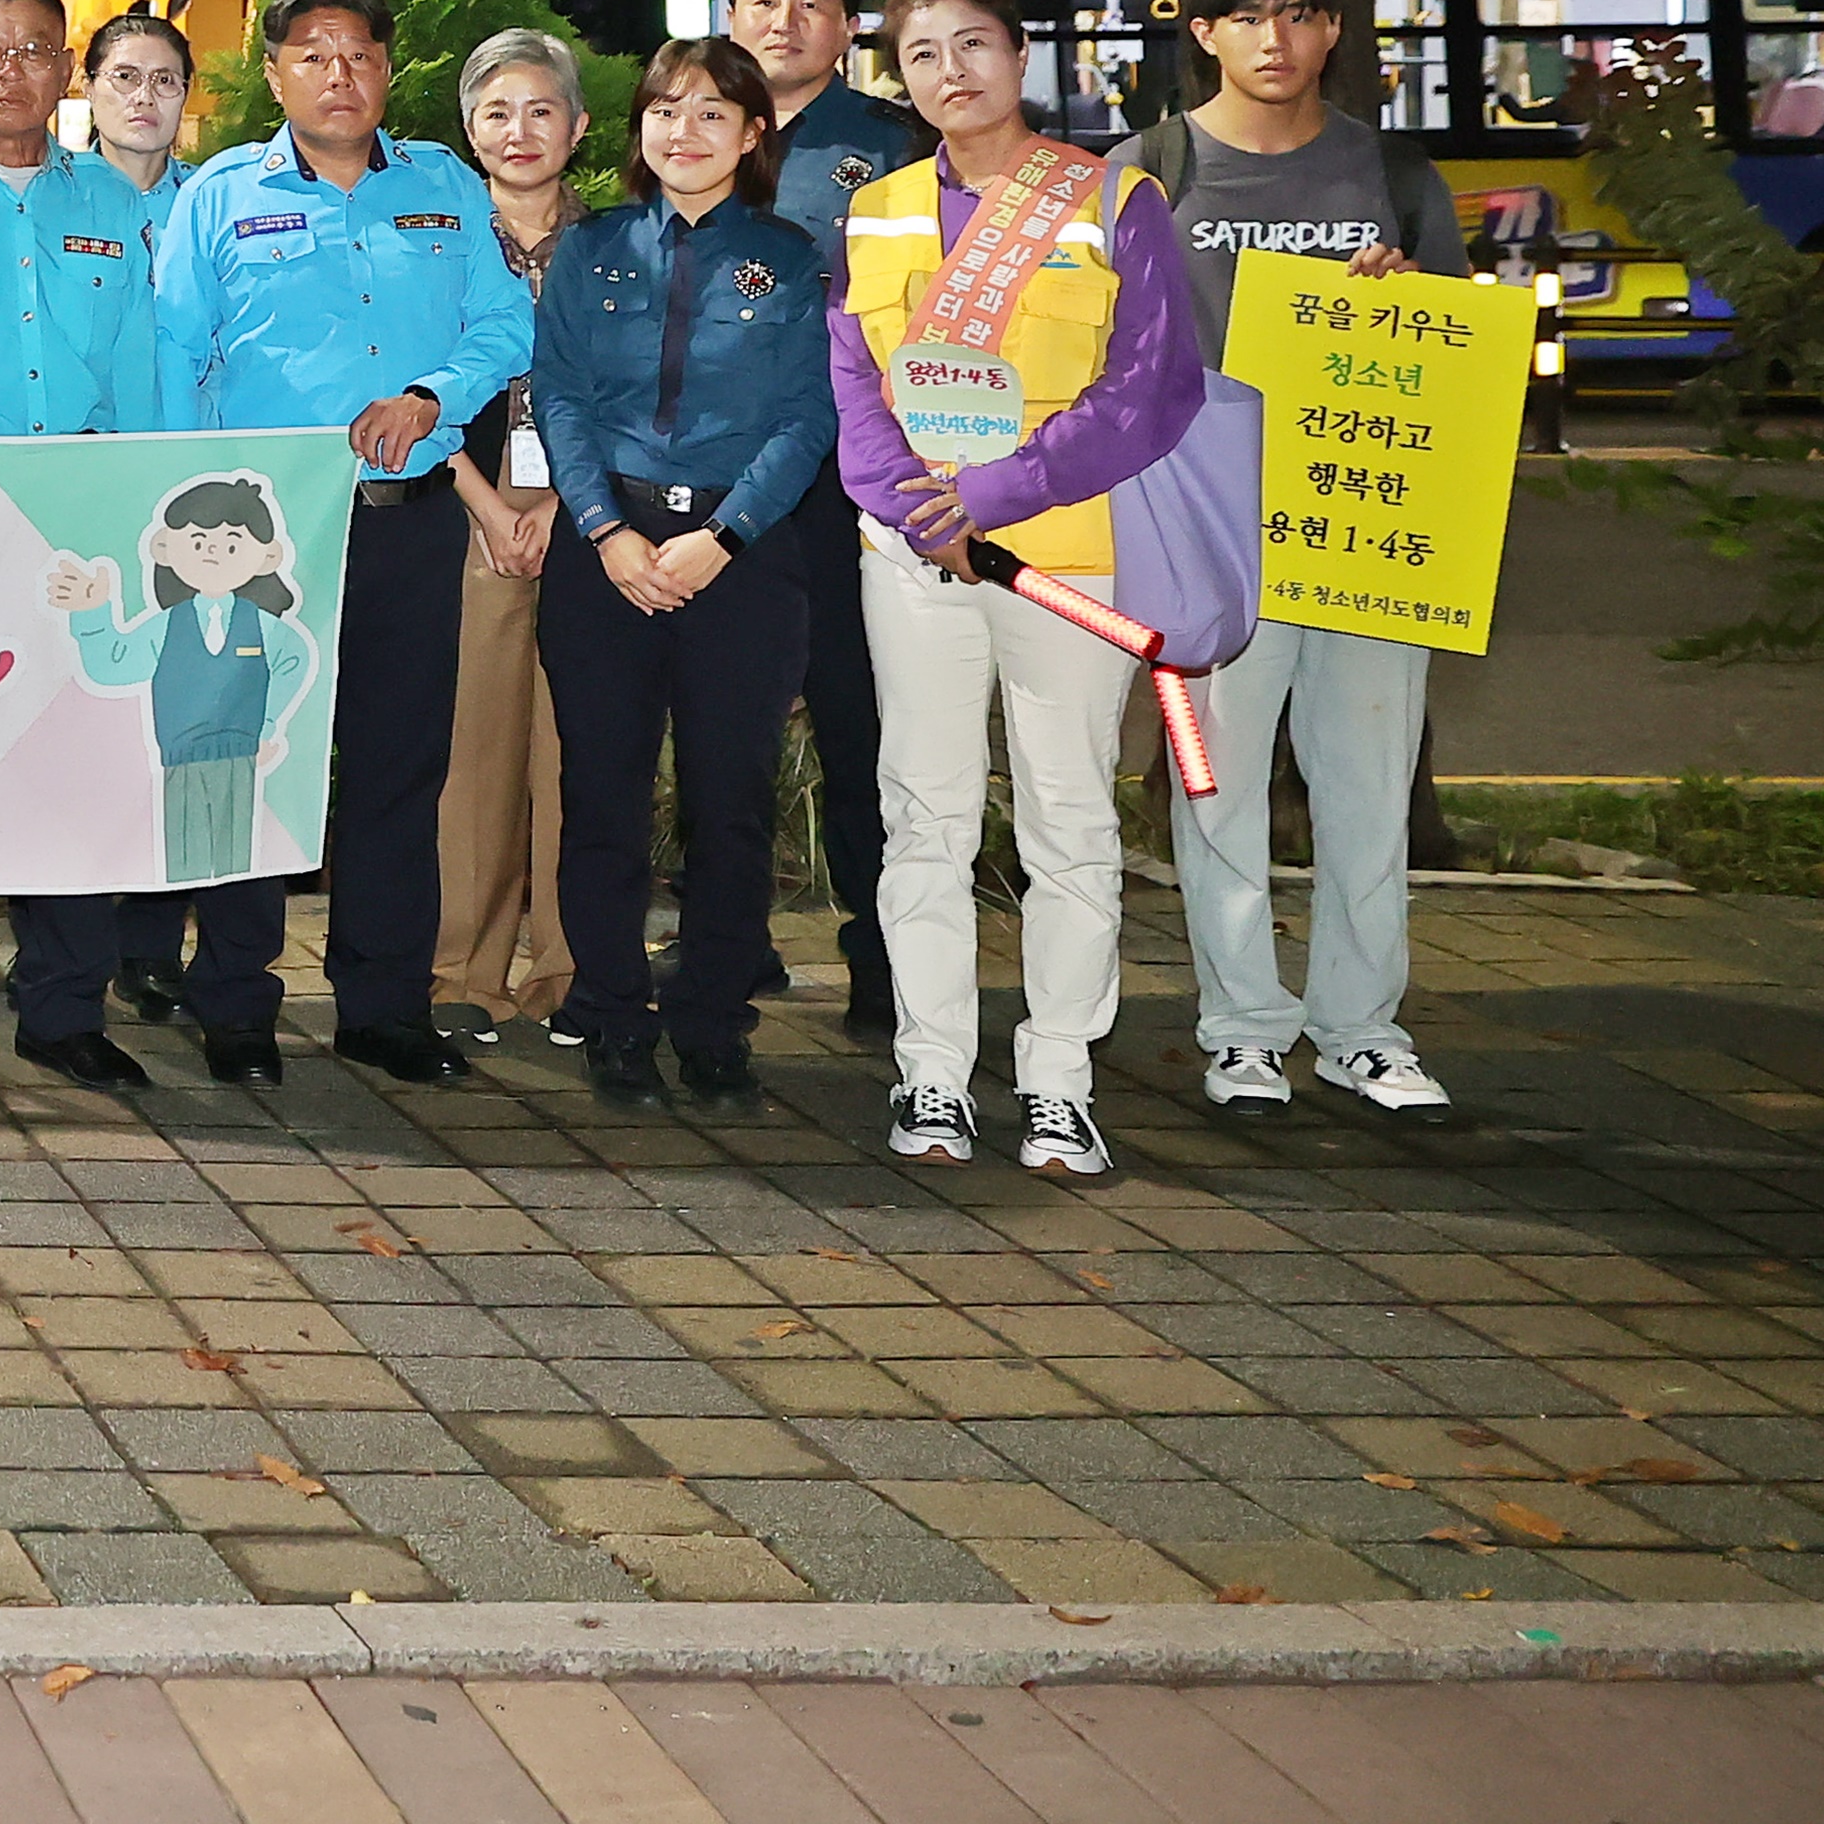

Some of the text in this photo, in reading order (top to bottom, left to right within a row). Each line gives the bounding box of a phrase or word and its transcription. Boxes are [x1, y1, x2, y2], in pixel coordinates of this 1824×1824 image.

[1019, 160, 1096, 242] 청소년을
[934, 147, 1060, 322] 유해환경으로부터
[1190, 219, 1382, 255] SATURDUER
[973, 242, 1034, 316] 사랑과
[1288, 291, 1474, 348] 꿈을 키우는
[1320, 351, 1423, 398] 청소년
[1295, 404, 1434, 452] 건강하고
[1306, 460, 1410, 507] 행복한
[1260, 510, 1330, 551] 용현
[1310, 585, 1472, 630] 청소년지도협의회
